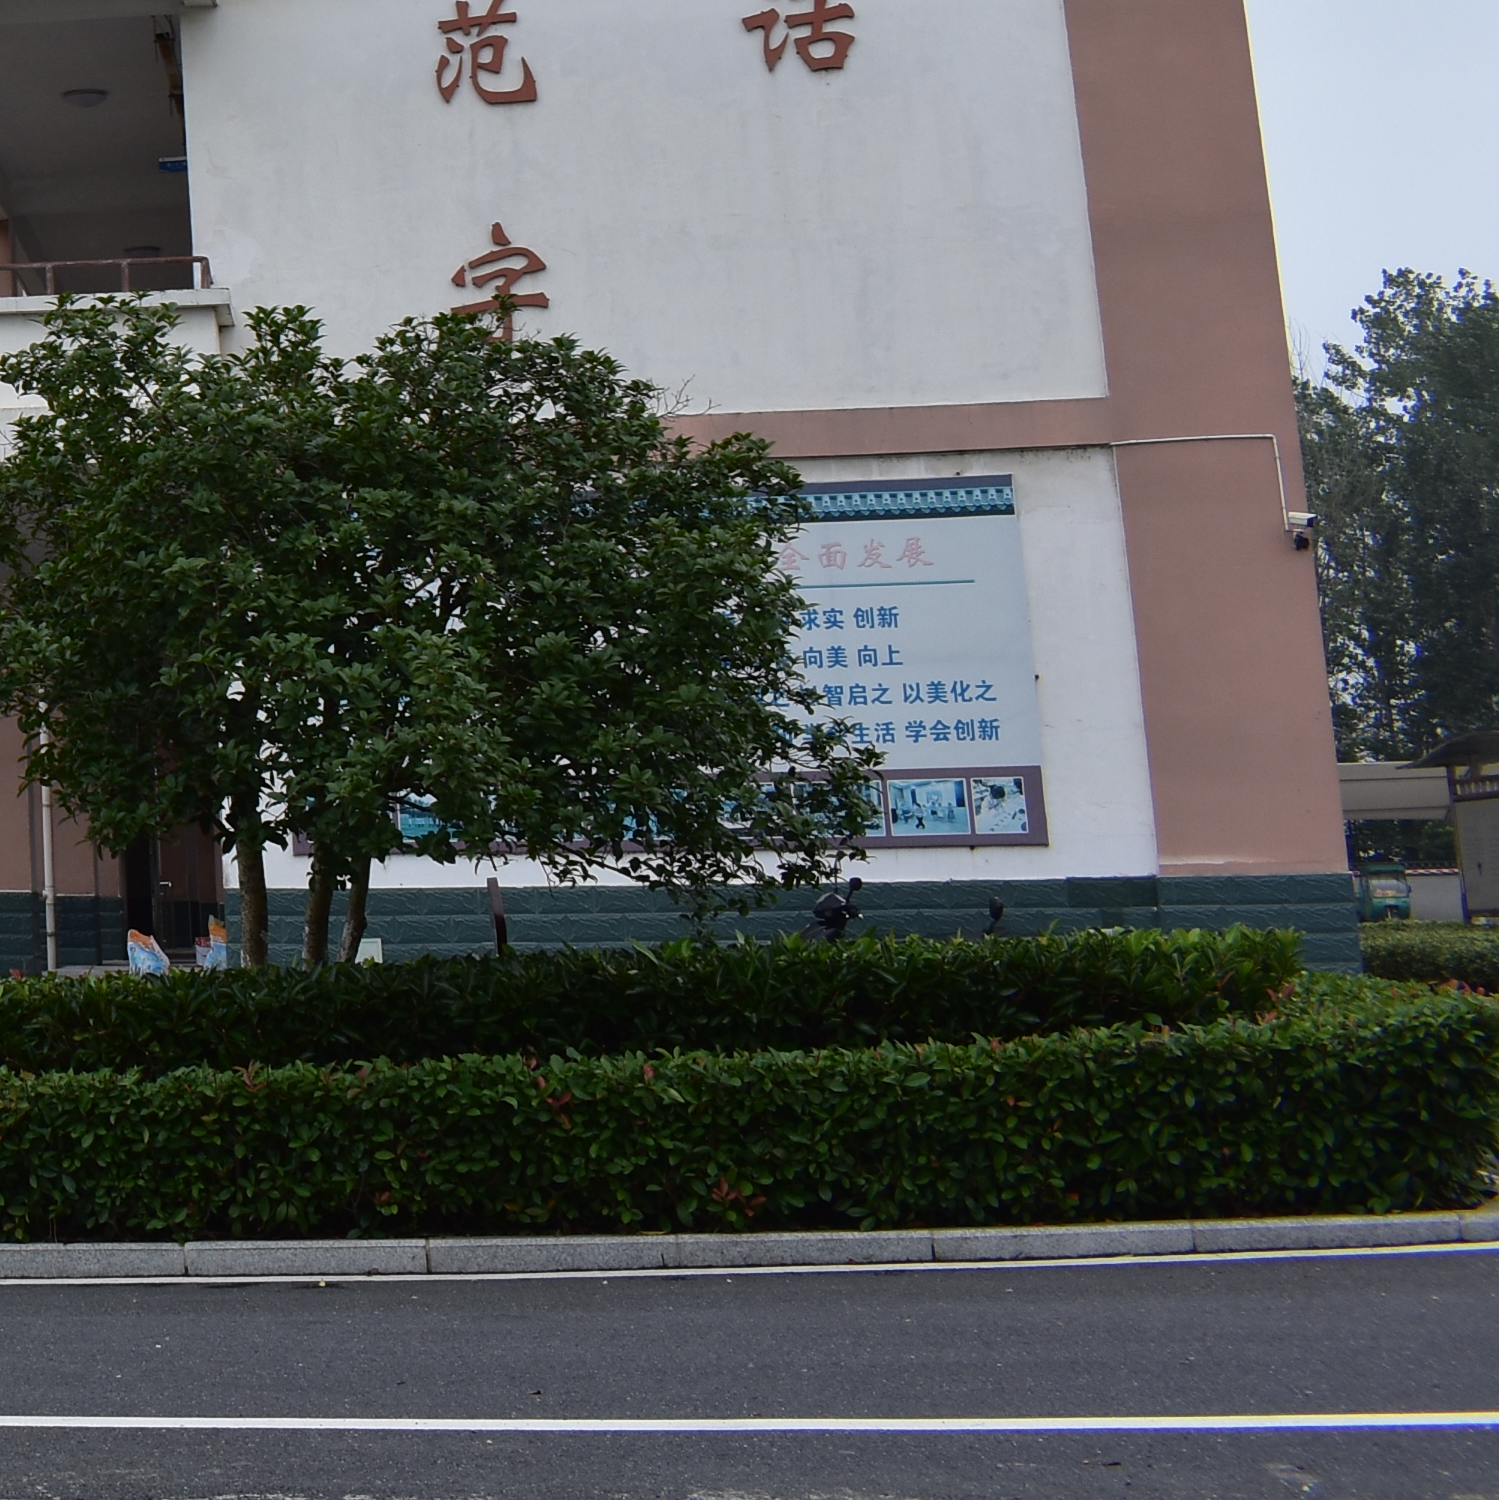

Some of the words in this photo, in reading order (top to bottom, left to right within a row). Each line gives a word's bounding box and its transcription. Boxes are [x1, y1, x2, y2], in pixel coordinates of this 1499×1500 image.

[778, 536, 933, 571] 全面发展
[800, 607, 844, 630] 求实
[853, 605, 900, 628] 创新
[803, 645, 849, 669] 向美
[857, 644, 903, 667] 向上
[902, 680, 997, 704] 以美化之
[905, 718, 1000, 742] 学会创新
